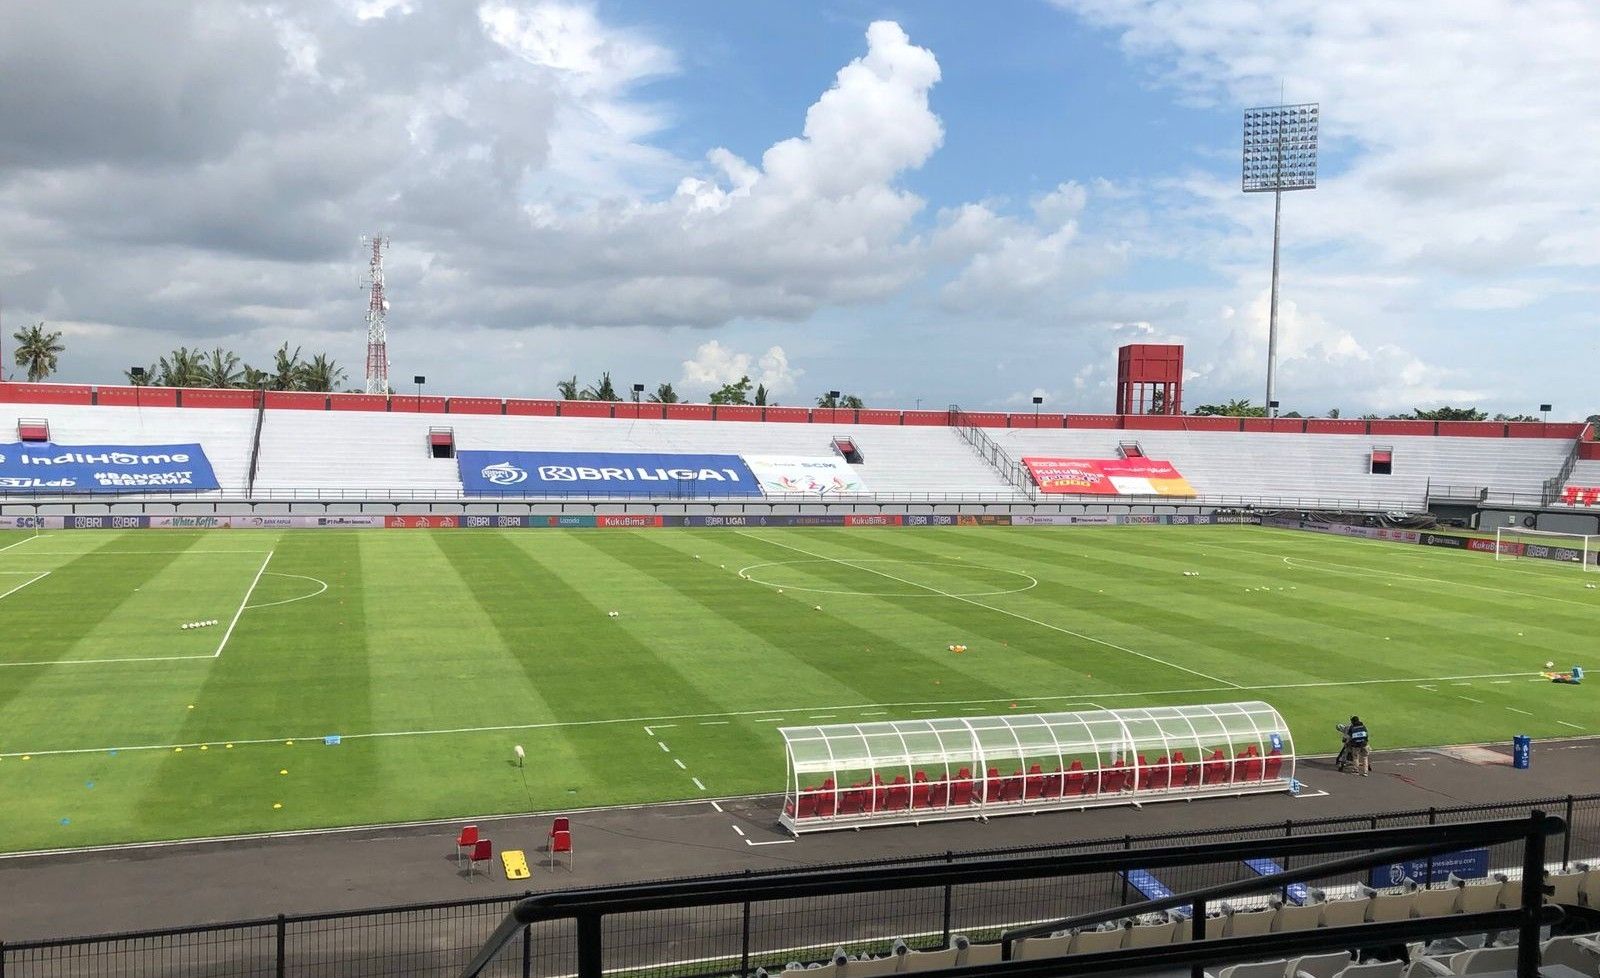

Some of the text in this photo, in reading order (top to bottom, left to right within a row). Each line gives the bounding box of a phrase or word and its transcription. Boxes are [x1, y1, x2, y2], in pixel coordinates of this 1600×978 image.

[21, 452, 190, 465] IndiHome
[94, 471, 193, 480] #BANGKIT
[576, 467, 635, 481] BRI
[99, 478, 193, 486] BERSAMA
[16, 516, 45, 528] SCM
[86, 517, 103, 528] BRI
[124, 517, 140, 528] BRI
[172, 516, 195, 527] White
[195, 516, 219, 528] Koffie
[477, 516, 490, 527] BRI
[507, 516, 521, 527] BRI
[605, 516, 645, 526] KukuBima
[713, 516, 724, 525] BRI
[915, 516, 927, 525] BRI
[1472, 540, 1509, 553] KukuBma
[1535, 546, 1549, 557] BRI
